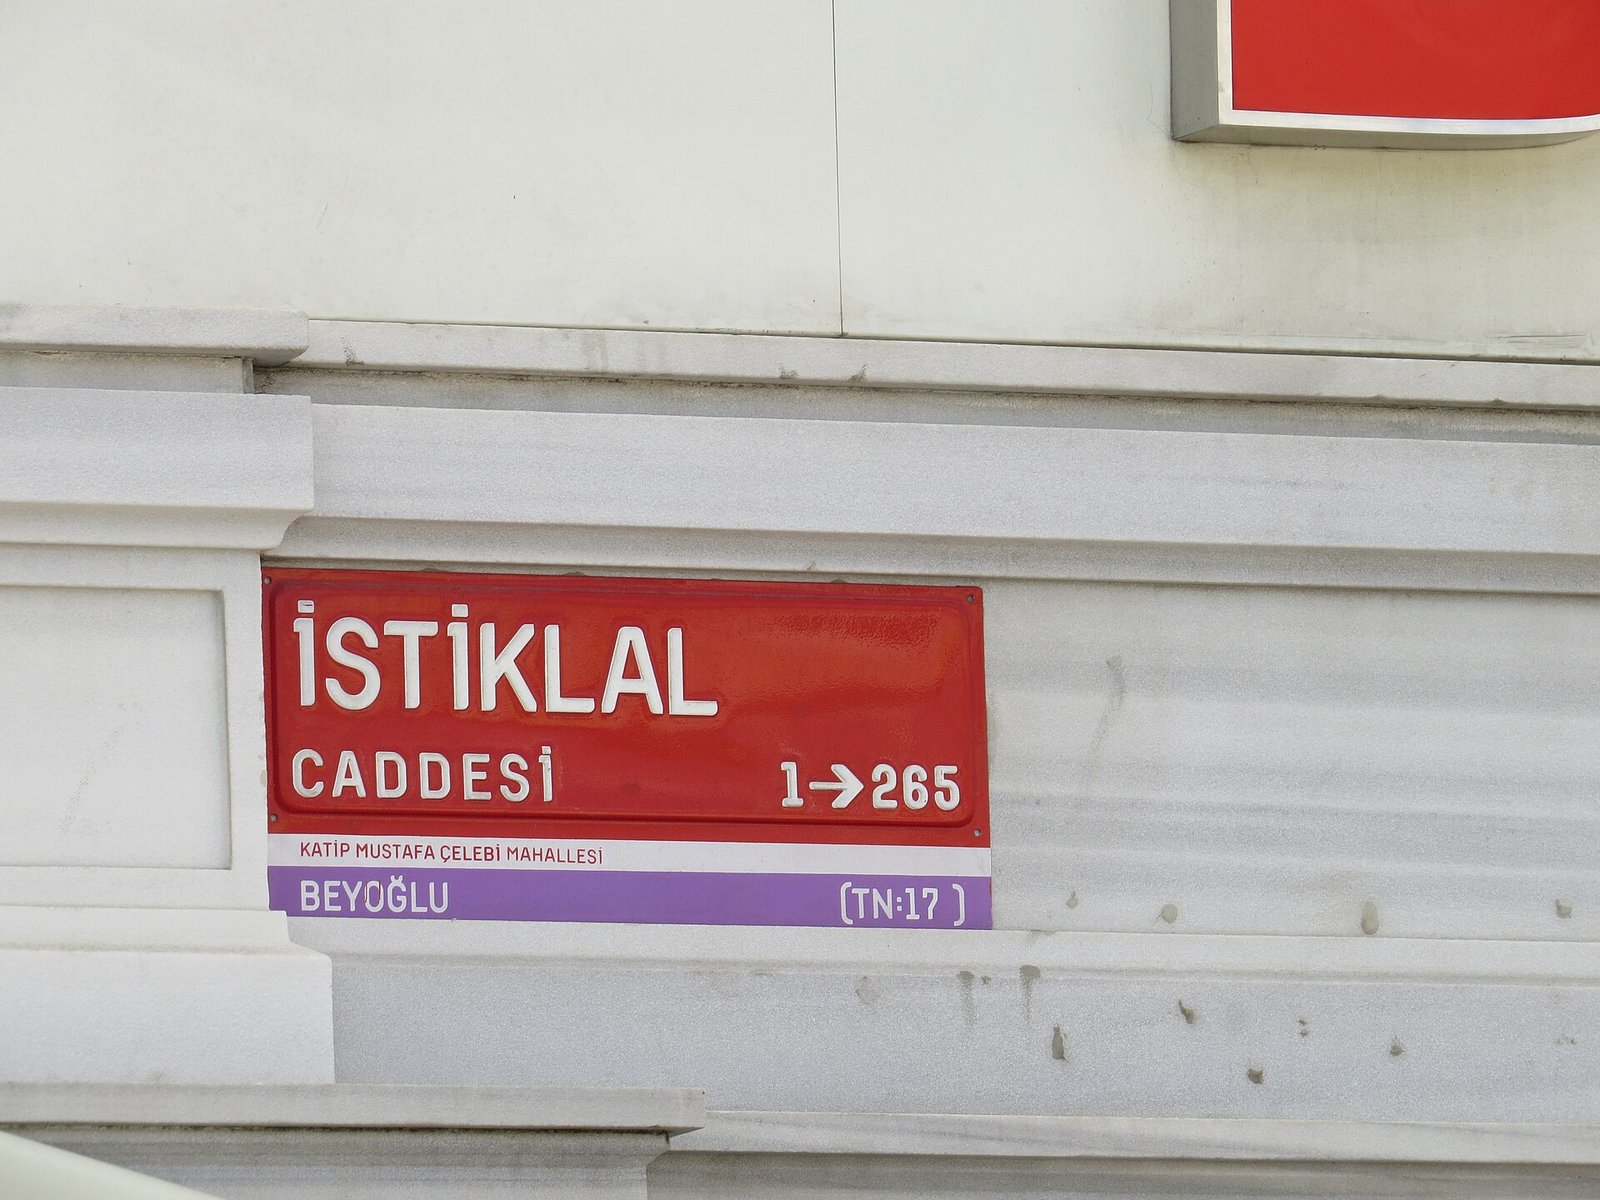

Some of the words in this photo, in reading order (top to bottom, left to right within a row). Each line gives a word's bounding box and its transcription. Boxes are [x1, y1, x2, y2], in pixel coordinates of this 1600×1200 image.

[293, 599, 718, 716] İSTİKLAL
[292, 745, 553, 802] CADDESİ
[780, 761, 804, 808] 1
[871, 763, 960, 811] 265
[300, 839, 350, 857] KATİP
[356, 843, 435, 860] MUSTAFA
[440, 843, 501, 863] ÇELEBİ
[507, 846, 603, 865] MAHALLESİ
[300, 875, 449, 913] BEYOĞLU
